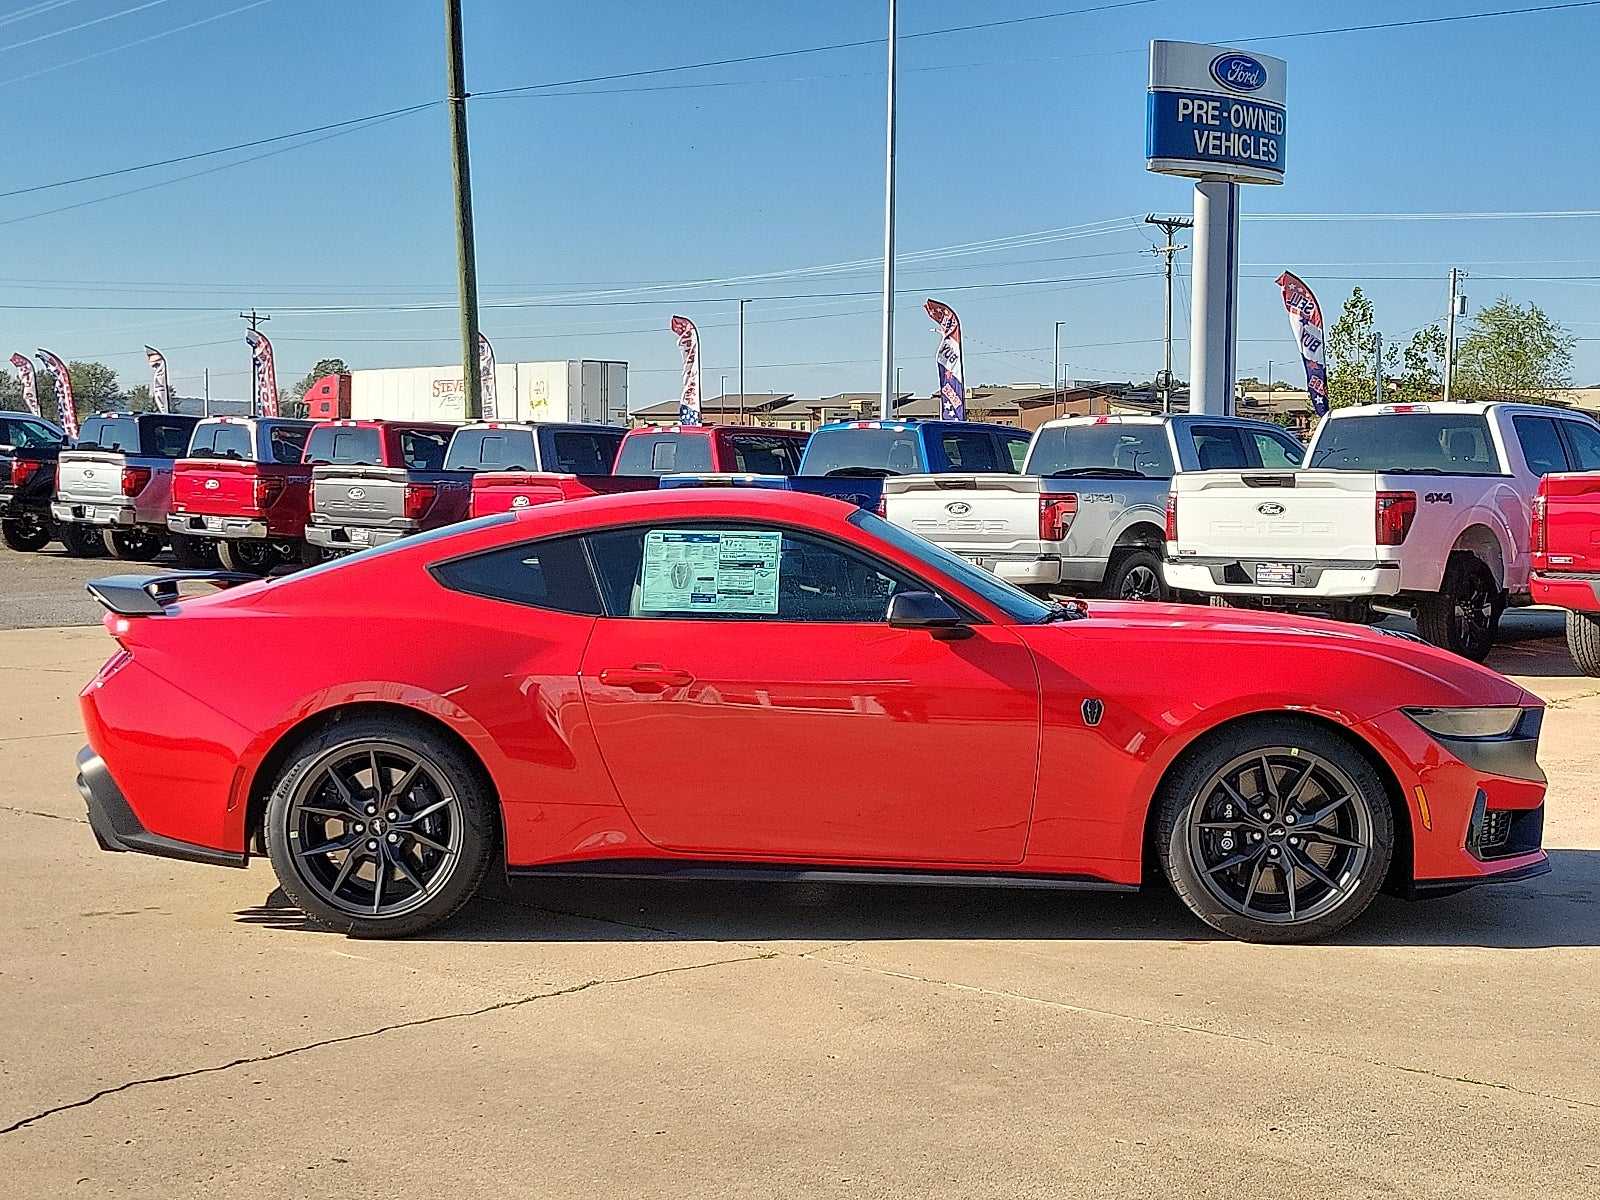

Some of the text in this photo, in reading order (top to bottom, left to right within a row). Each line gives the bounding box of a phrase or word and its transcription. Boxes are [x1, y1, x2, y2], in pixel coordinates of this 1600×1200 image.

[1227, 59, 1260, 87] Ford
[1177, 98, 1284, 136] PRE-OWNED
[1193, 129, 1277, 163] VEHICLES
[433, 380, 465, 397] STEVE
[1260, 503, 1282, 515] Ford
[1209, 520, 1336, 535] F-150
